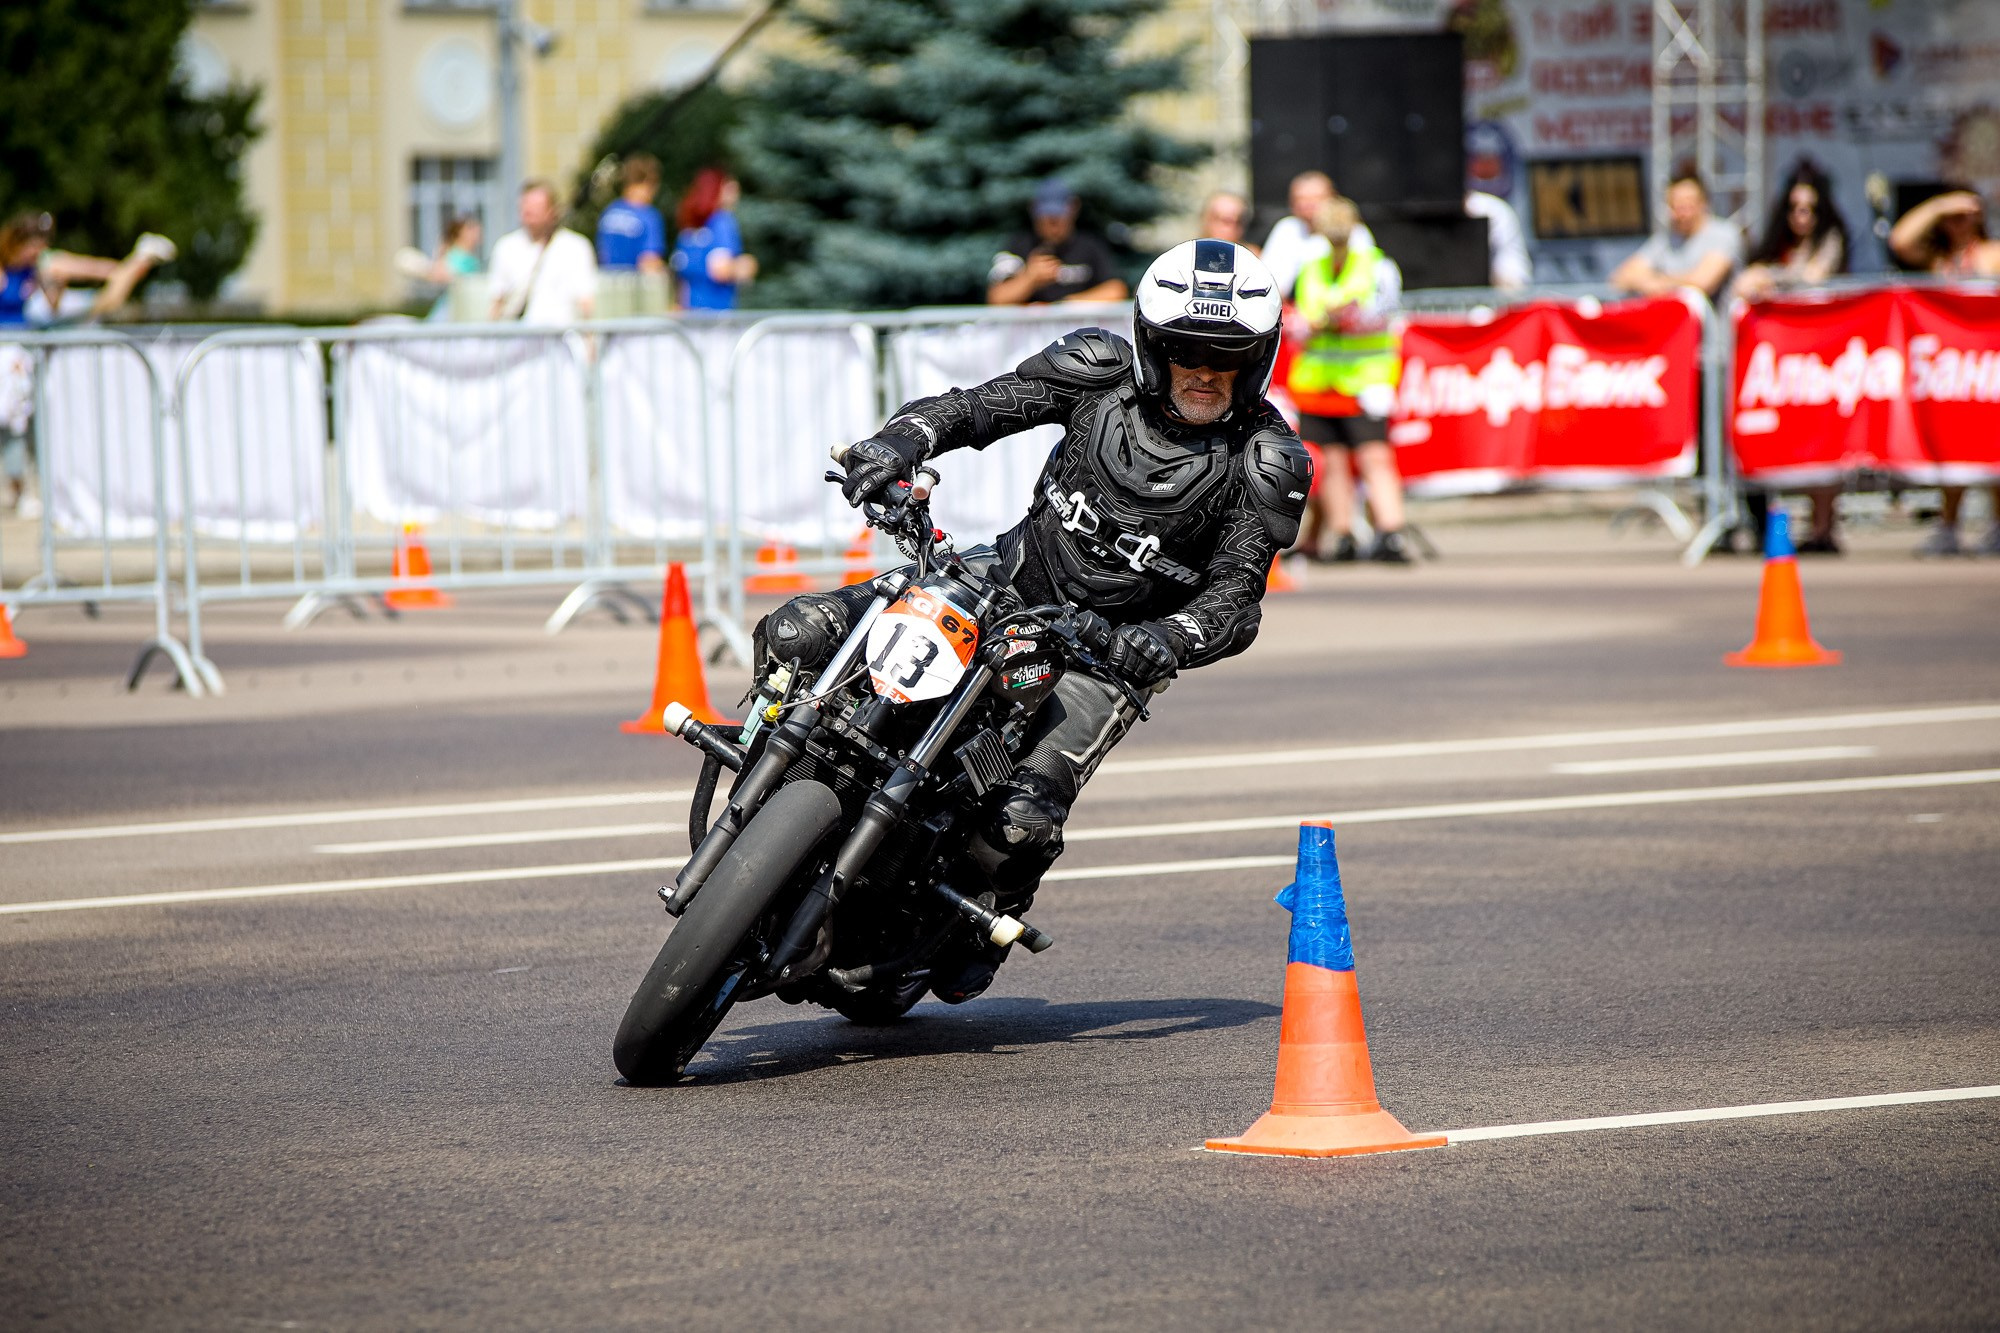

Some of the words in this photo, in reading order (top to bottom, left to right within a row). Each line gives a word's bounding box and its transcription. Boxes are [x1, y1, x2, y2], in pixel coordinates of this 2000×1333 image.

[1192, 302, 1231, 317] SHOEI
[1546, 343, 1668, 409] Банк
[1738, 336, 1904, 418] Альфа
[1908, 333, 2000, 402] Бан
[868, 623, 939, 688] 13
[1016, 659, 1052, 682] Matris
